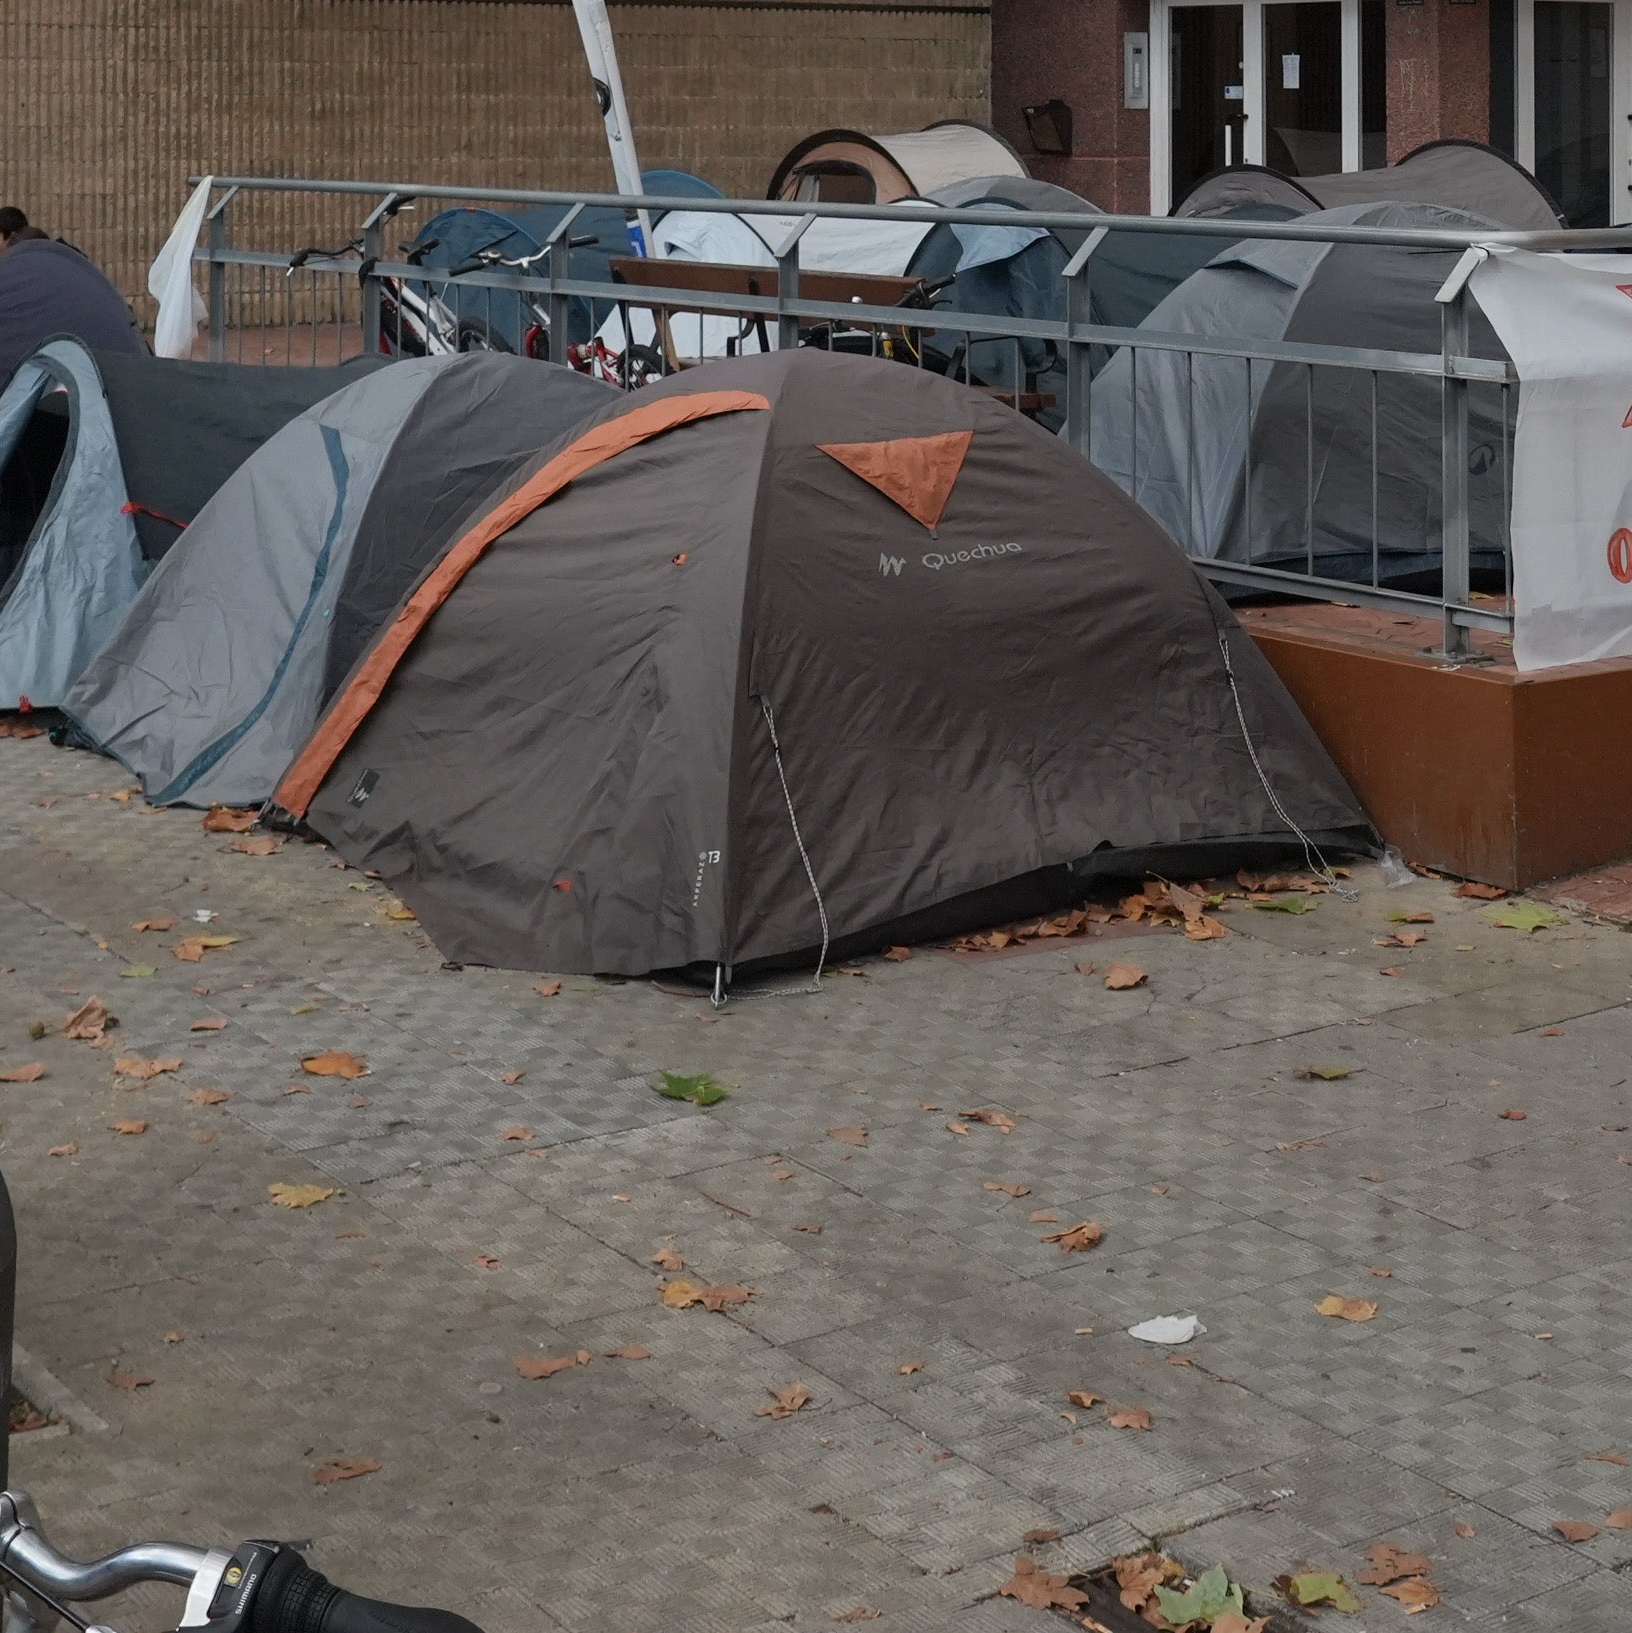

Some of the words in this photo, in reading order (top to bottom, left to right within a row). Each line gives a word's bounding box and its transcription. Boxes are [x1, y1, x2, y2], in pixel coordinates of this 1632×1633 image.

[922, 542, 1023, 570] Quechua
[708, 850, 721, 864] T3
[234, 1573, 257, 1616] SHIMANO
